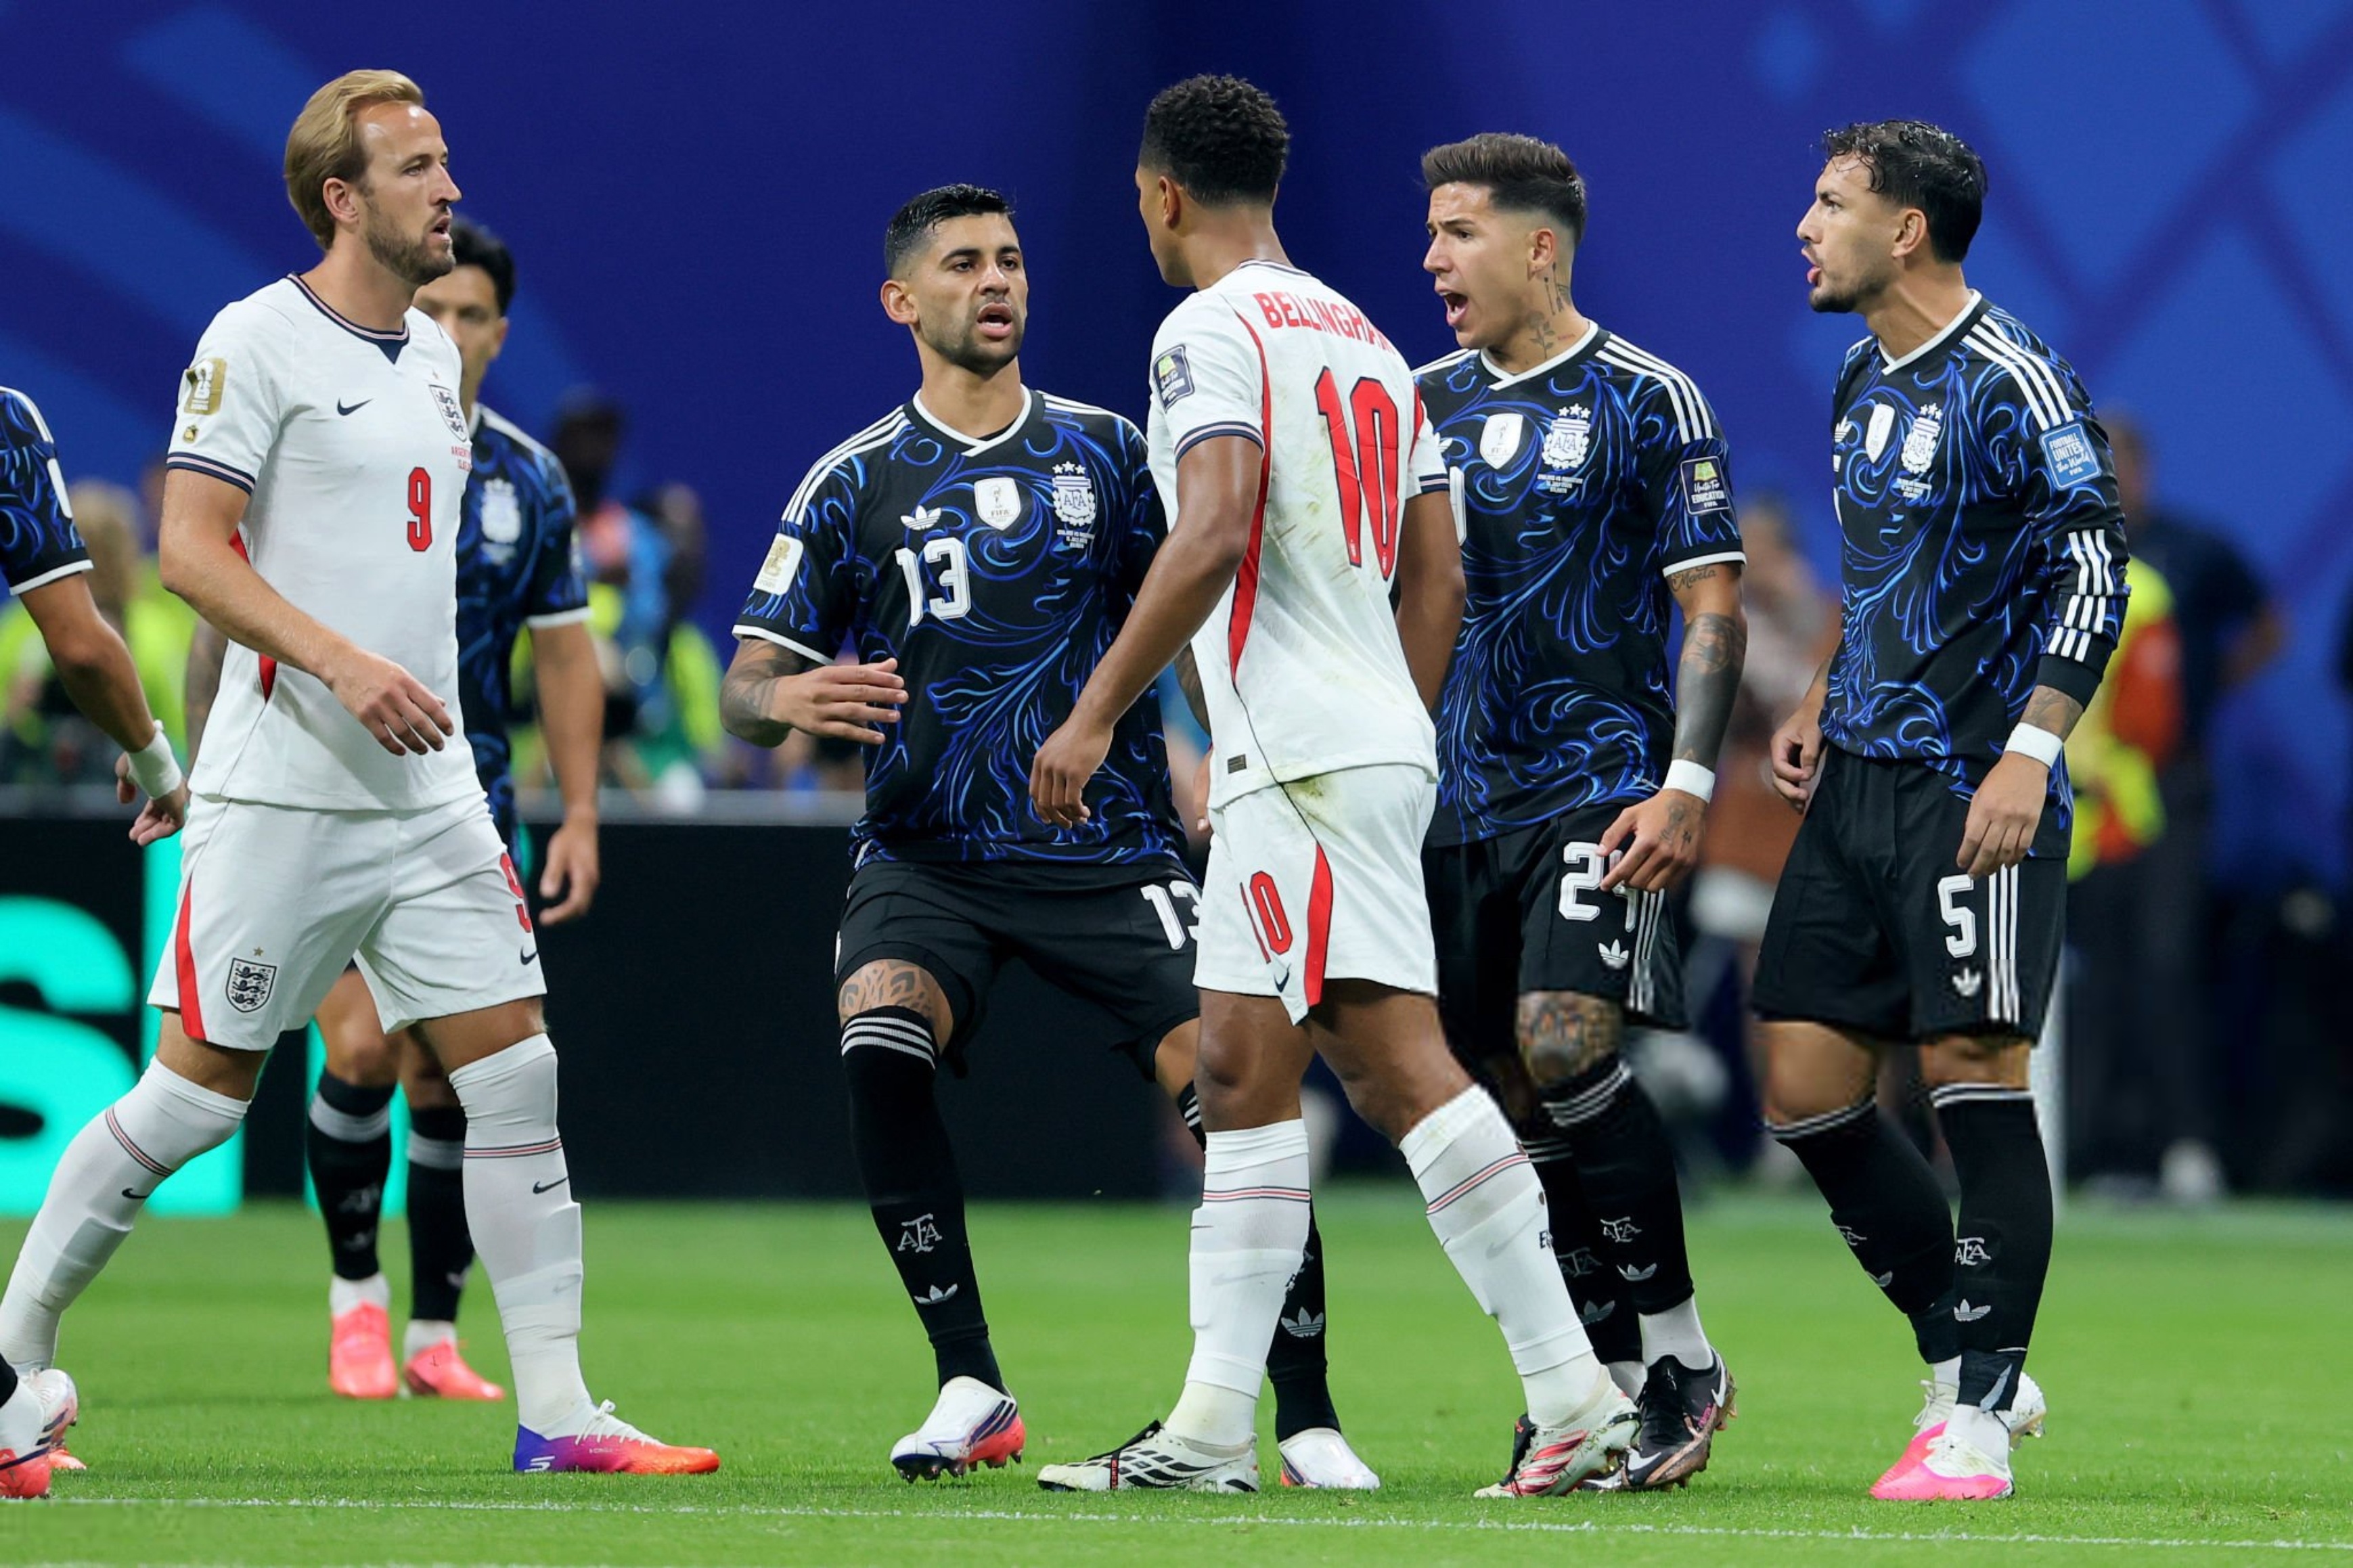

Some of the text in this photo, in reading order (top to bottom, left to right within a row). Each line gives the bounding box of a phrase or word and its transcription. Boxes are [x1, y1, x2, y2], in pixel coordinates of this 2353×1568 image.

[2049, 432, 2080, 450] FOOTBALL
[2052, 441, 2084, 462] UNITES
[1063, 489, 1087, 510] AFA
[1314, 366, 1399, 581] 10
[407, 467, 432, 552] 9
[895, 537, 972, 626] 13
[499, 852, 532, 933] 9
[1240, 870, 1293, 964] 10
[1937, 874, 1977, 958] 5
[897, 1213, 943, 1253] AFA
[1600, 1216, 1642, 1242] AFA
[1954, 1237, 1992, 1265] AFA
